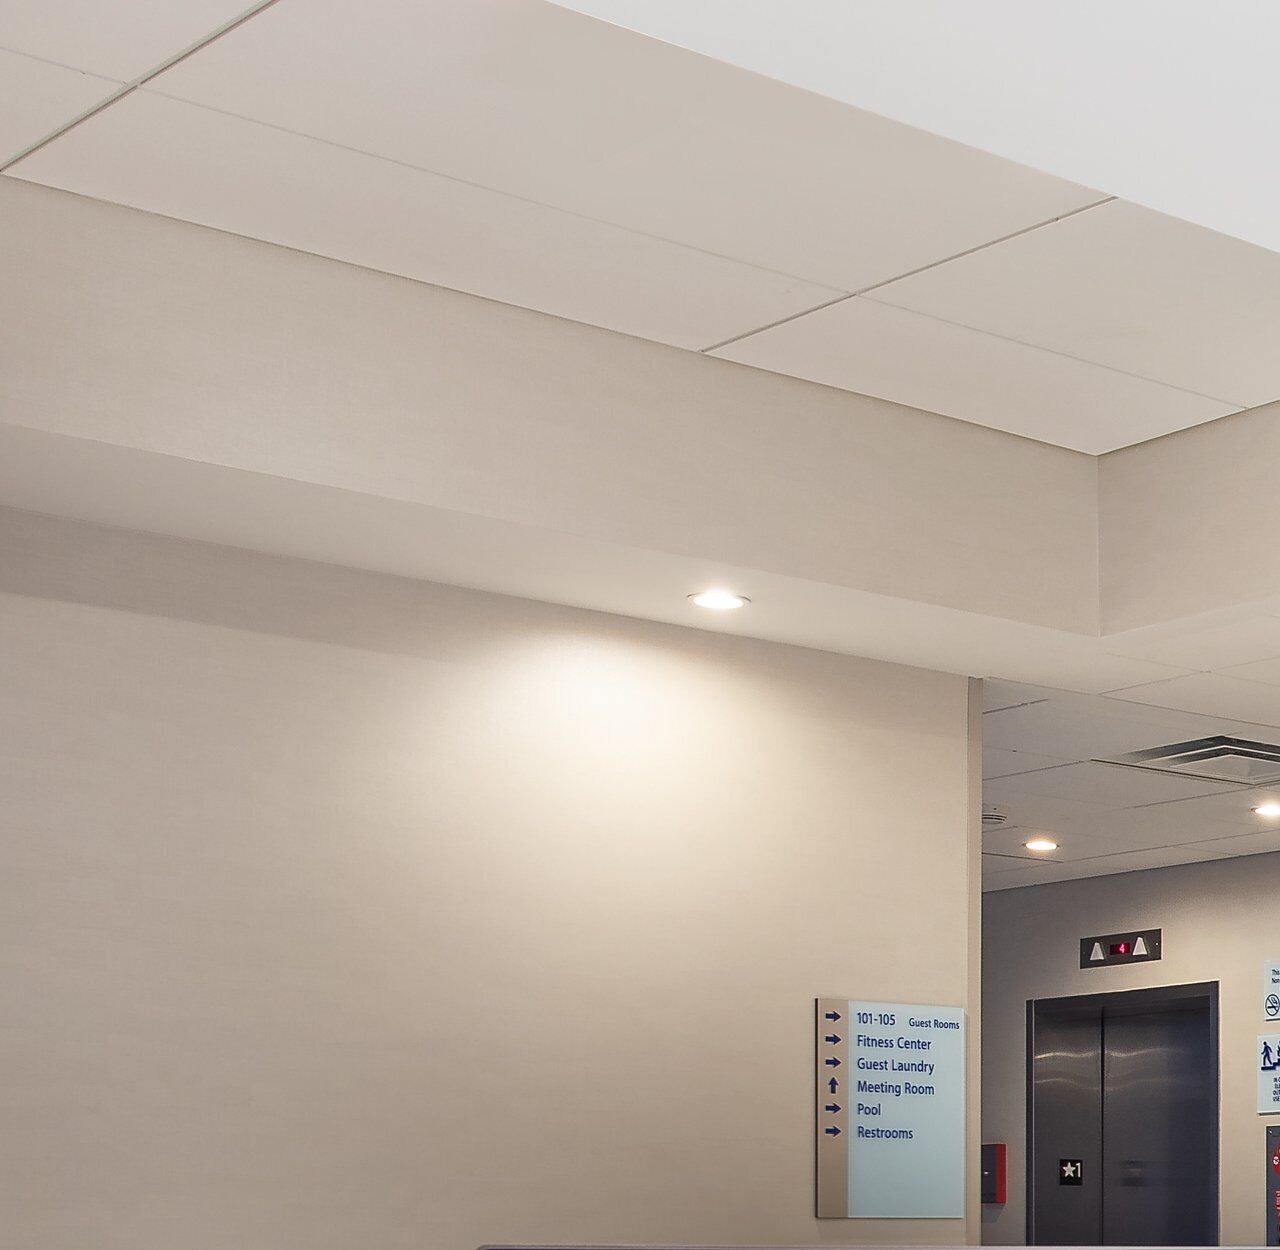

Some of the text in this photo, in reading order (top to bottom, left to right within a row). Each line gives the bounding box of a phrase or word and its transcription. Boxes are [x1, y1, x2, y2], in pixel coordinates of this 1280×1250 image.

[1119, 943, 1126, 954] 4
[857, 1012, 896, 1026] 101-105
[908, 1017, 960, 1030] Guest Rooms
[857, 1034, 932, 1050] Fitness Center
[857, 1057, 935, 1076] Guest Laundry
[857, 1080, 935, 1097] Meeting Room
[857, 1102, 881, 1116] Pool
[857, 1125, 914, 1140] Restrooms
